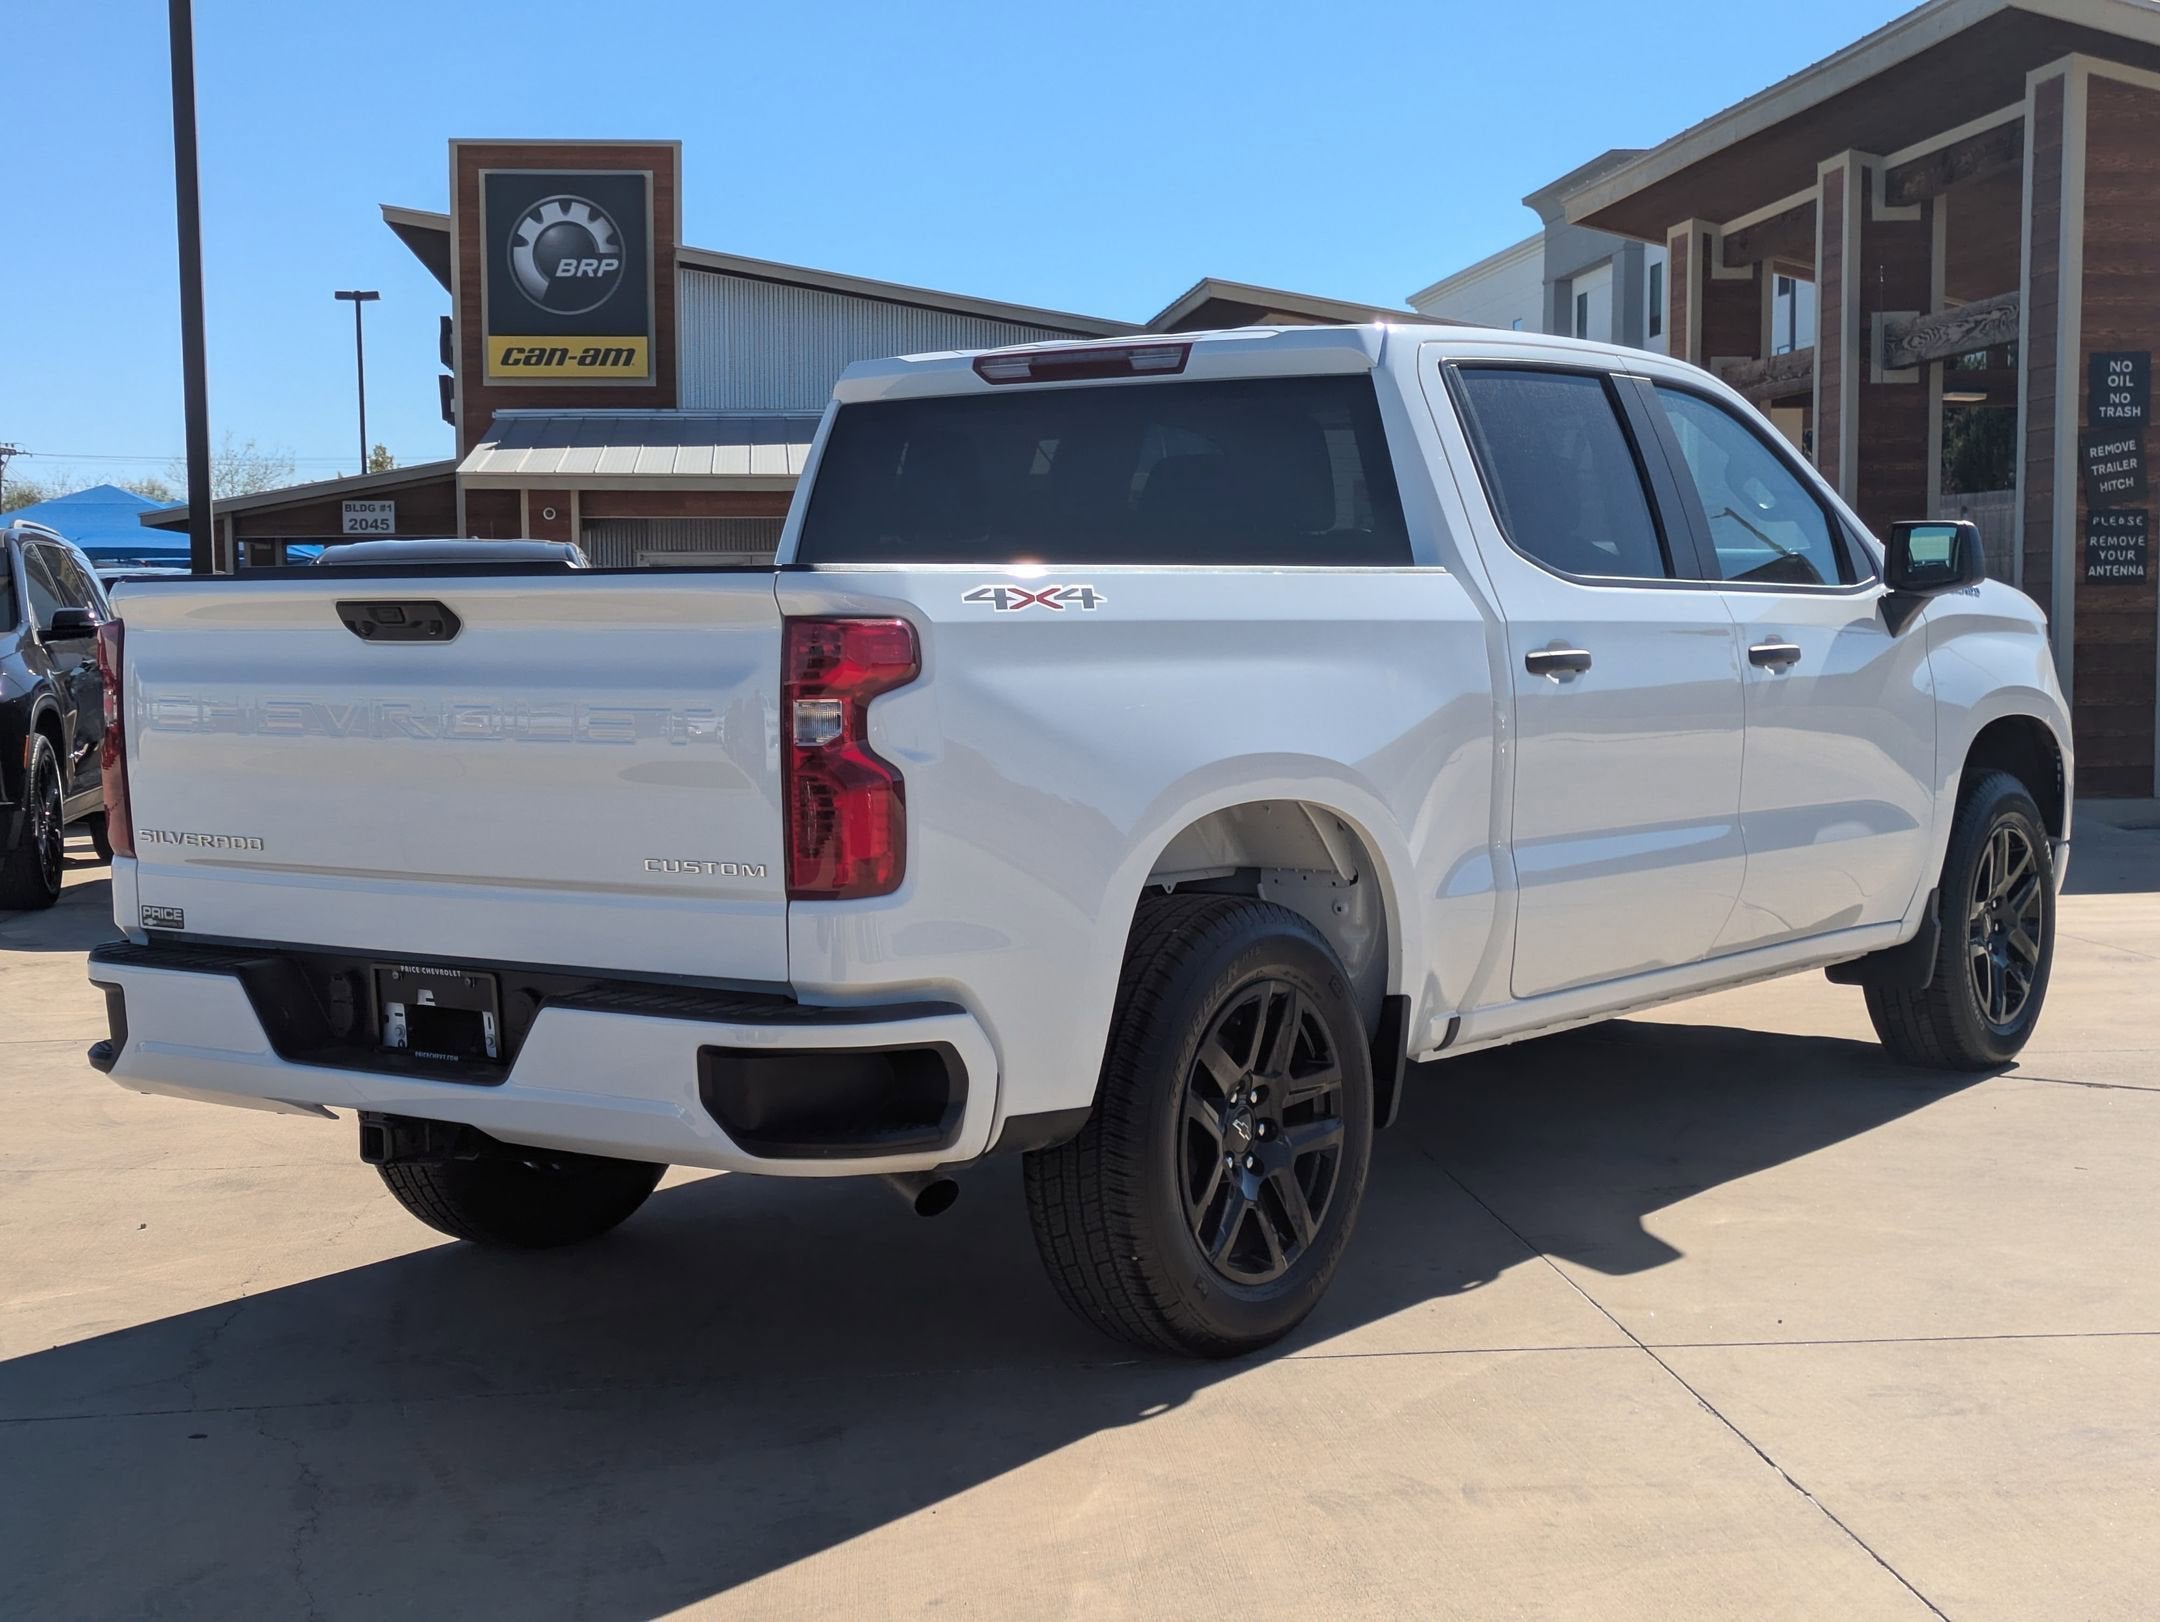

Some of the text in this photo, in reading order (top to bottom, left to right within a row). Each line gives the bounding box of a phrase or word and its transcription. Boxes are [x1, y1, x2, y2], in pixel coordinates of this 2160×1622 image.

[555, 258, 619, 278] BRP
[500, 346, 637, 367] can-am
[2109, 360, 2133, 373] NO
[2107, 374, 2134, 388] OIL
[2109, 392, 2131, 404] NO
[2099, 405, 2142, 418] TRASH
[2089, 440, 2136, 459] REMOVE
[2091, 458, 2138, 476] TRAILER
[2099, 477, 2135, 493] HITCH
[344, 503, 393, 513] BLDG #1
[348, 518, 391, 531] 2045
[2089, 535, 2146, 546] REMOVE
[2099, 550, 2136, 561] YOUR
[2087, 565, 2145, 577] ANTENNA
[139, 829, 264, 851] SILVERADO
[643, 858, 768, 878] CUSTOM
[142, 906, 183, 921] PRICE
[400, 965, 462, 977] PRICE CHEVROLET
